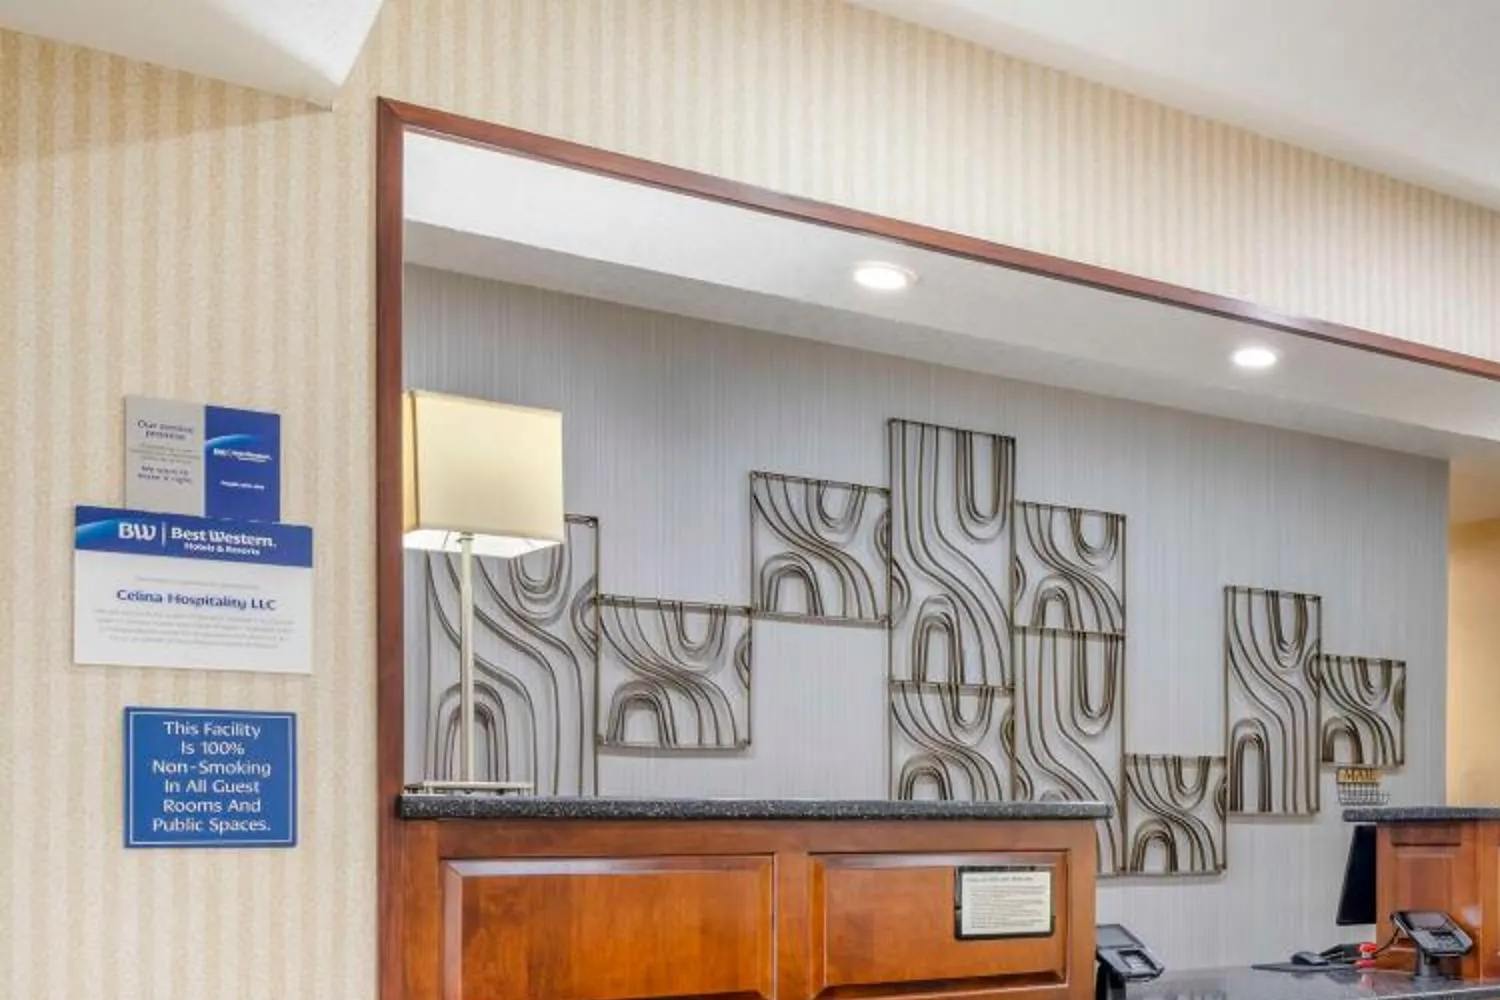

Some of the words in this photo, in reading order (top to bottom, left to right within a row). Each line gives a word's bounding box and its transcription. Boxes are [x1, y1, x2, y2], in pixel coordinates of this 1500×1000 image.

[118, 522, 156, 541] BW
[171, 527, 206, 541] Best
[183, 542, 215, 552] Hotels
[226, 545, 261, 556] Resorts
[116, 589, 162, 604] Celina
[168, 593, 247, 610] Hospitality
[251, 598, 277, 610] LLC
[163, 721, 198, 736] This
[204, 722, 261, 739] Facility
[181, 741, 195, 755] Is
[202, 741, 245, 755] 100%
[152, 759, 271, 778] Non-Smoking
[165, 779, 180, 793] In
[186, 779, 206, 793] All
[213, 780, 260, 794] Guest
[163, 799, 222, 813] Rooms
[227, 799, 261, 813] And
[152, 818, 204, 832] Public
[209, 818, 271, 835] Spaces.
